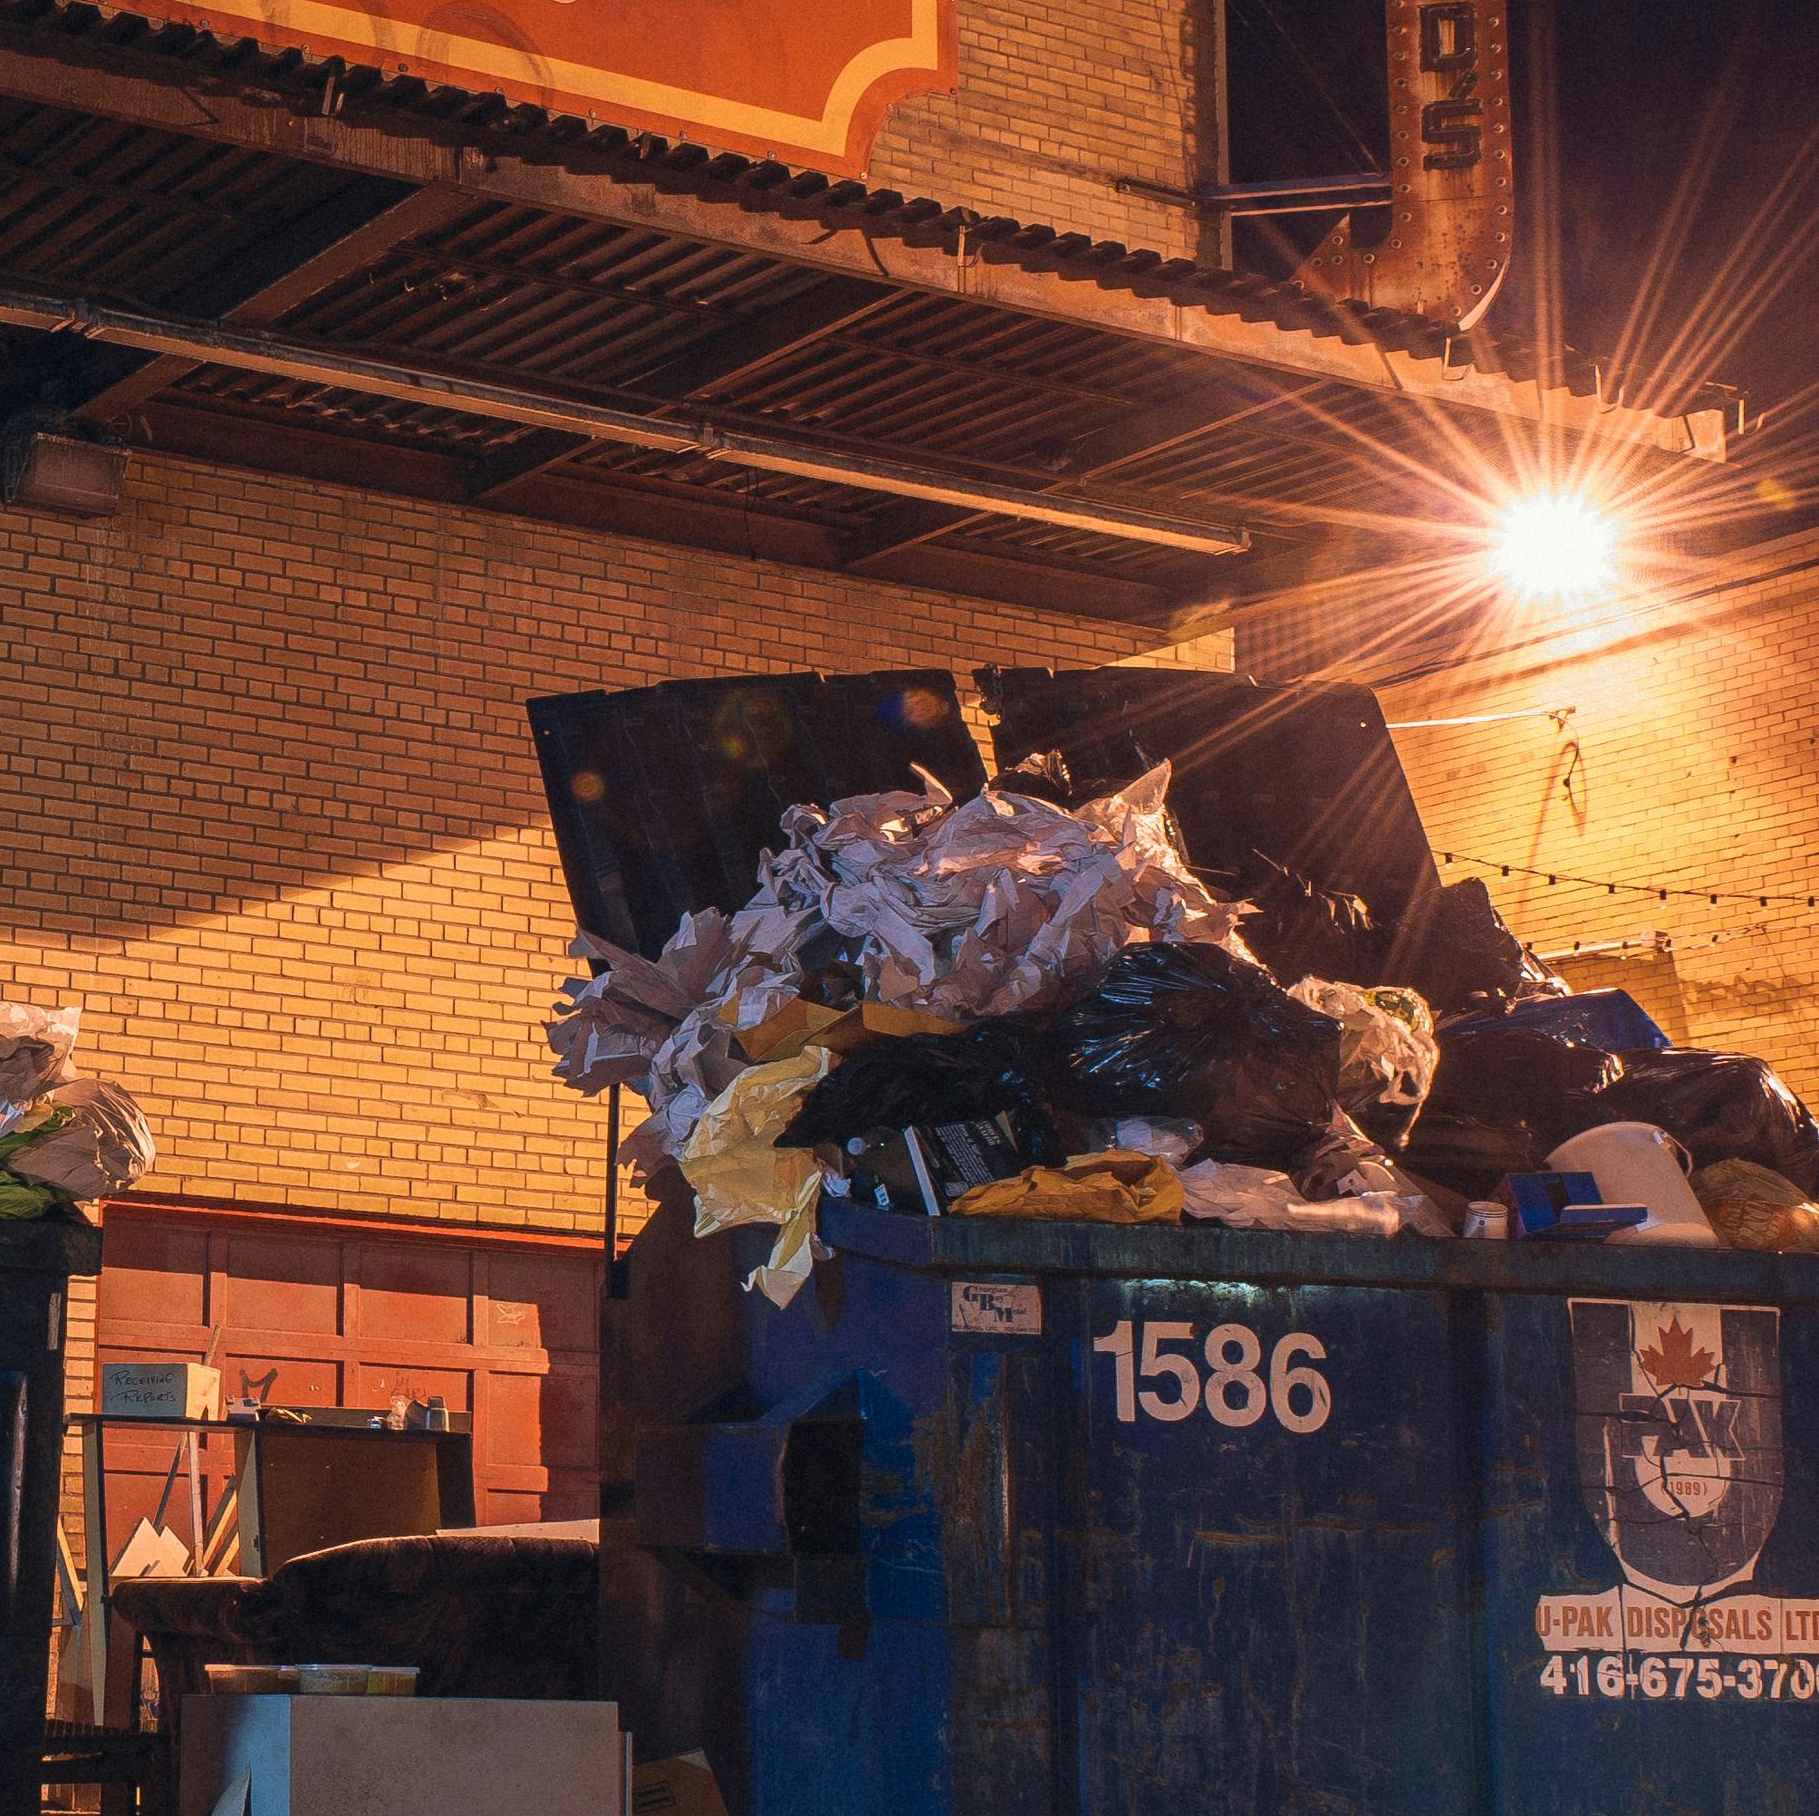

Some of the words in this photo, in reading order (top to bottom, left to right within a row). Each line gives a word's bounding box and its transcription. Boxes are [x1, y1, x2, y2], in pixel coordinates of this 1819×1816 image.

[109, 1370, 175, 1386] RECEIVING
[1092, 1319, 1332, 1434] 1586
[110, 1389, 177, 1405] REPORTS
[1535, 1604, 1614, 1639] U-PAK
